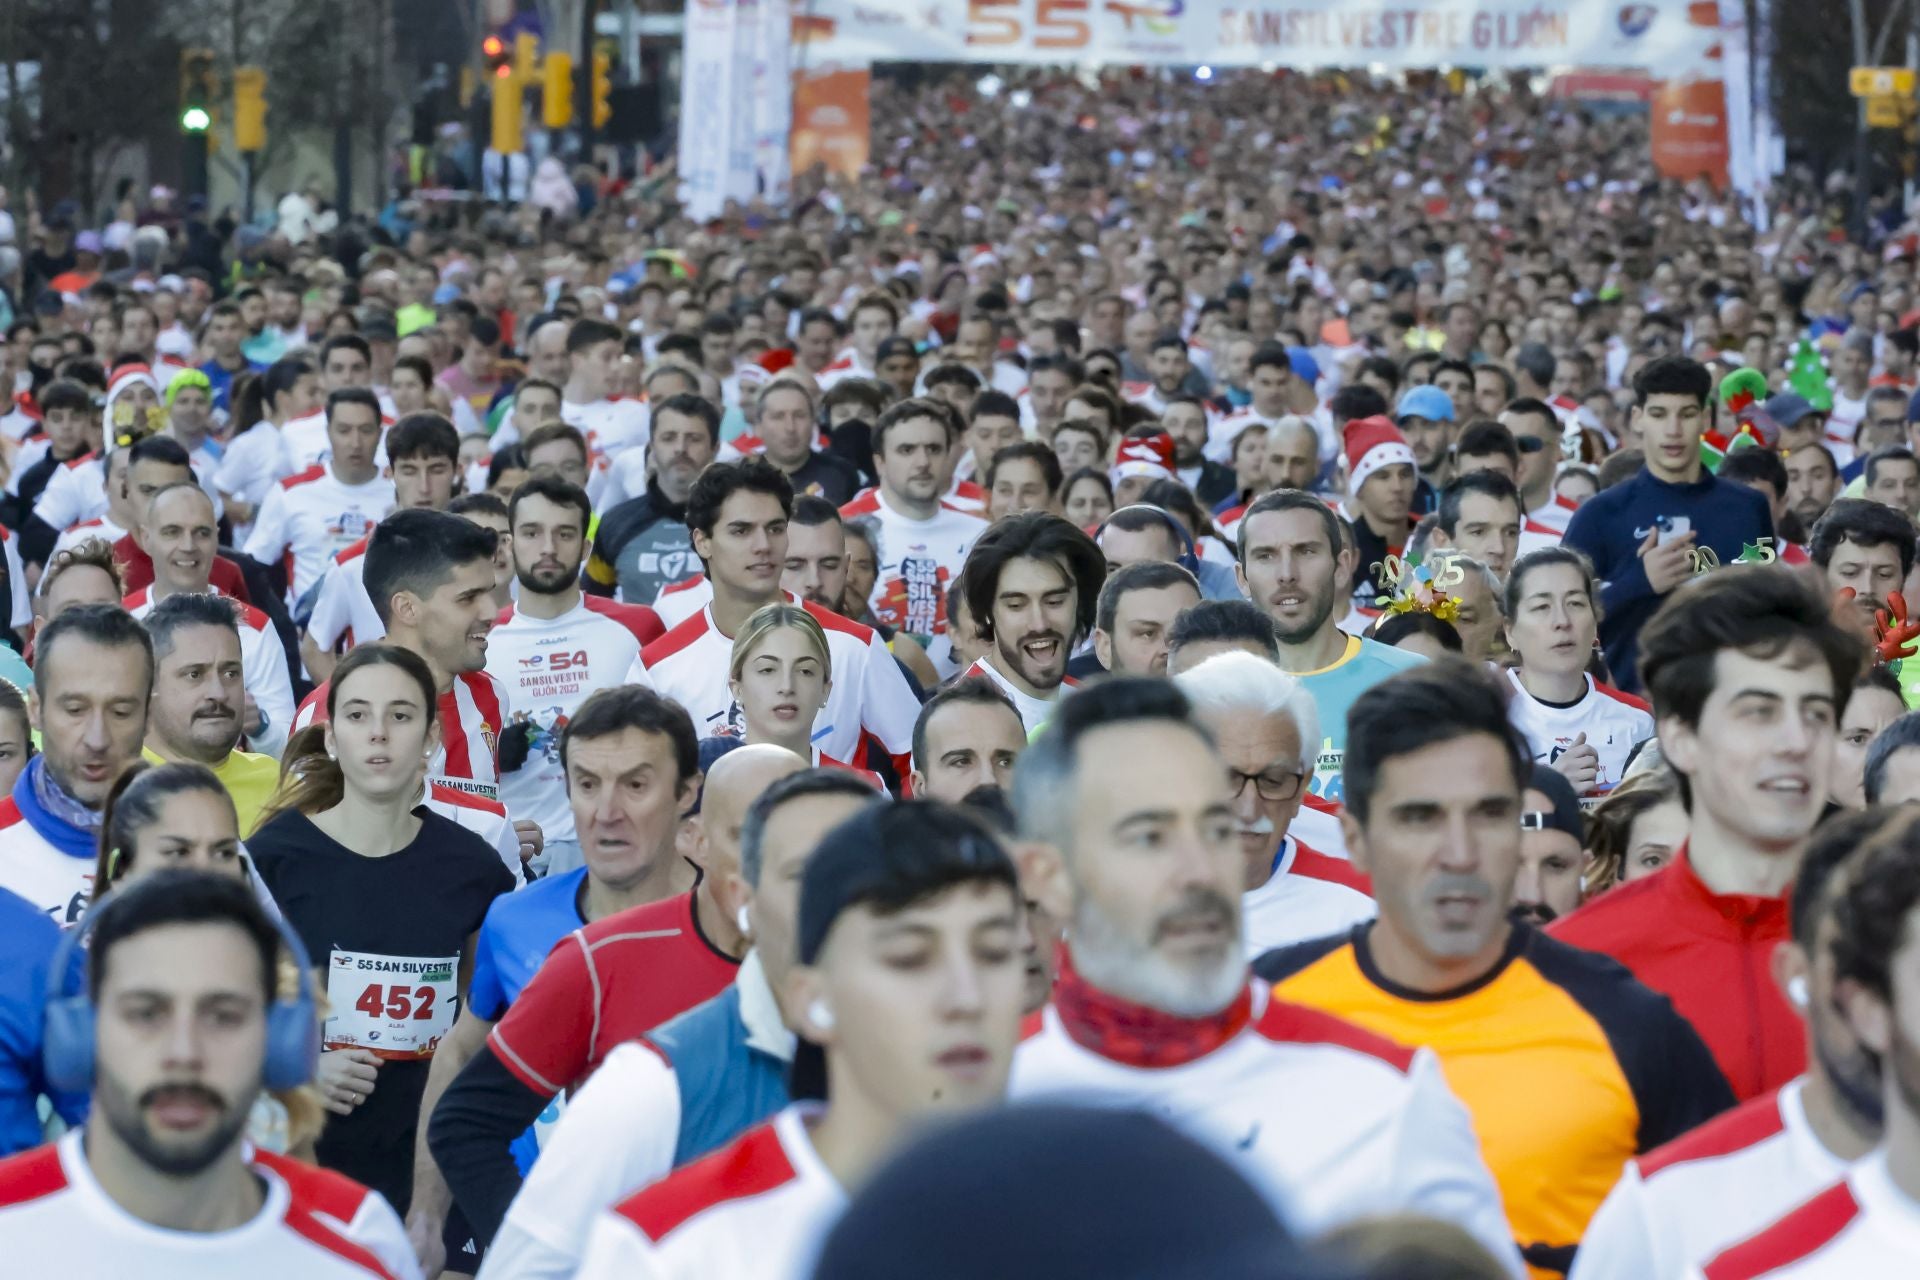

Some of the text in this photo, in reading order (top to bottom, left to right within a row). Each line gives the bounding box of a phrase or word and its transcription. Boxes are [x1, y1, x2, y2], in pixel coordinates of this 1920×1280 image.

[966, 0, 1092, 47] 55
[907, 585, 936, 600] SIL
[907, 600, 936, 616] VES
[904, 616, 935, 635] TRE
[549, 650, 588, 671] 54
[520, 671, 591, 688] SANSILVESTRE
[532, 684, 580, 697] GIJÓN 2023
[464, 783, 497, 796] SILVESTRE
[357, 959, 453, 974] 55 SAN SILVESTRE
[355, 984, 437, 1020] 452
